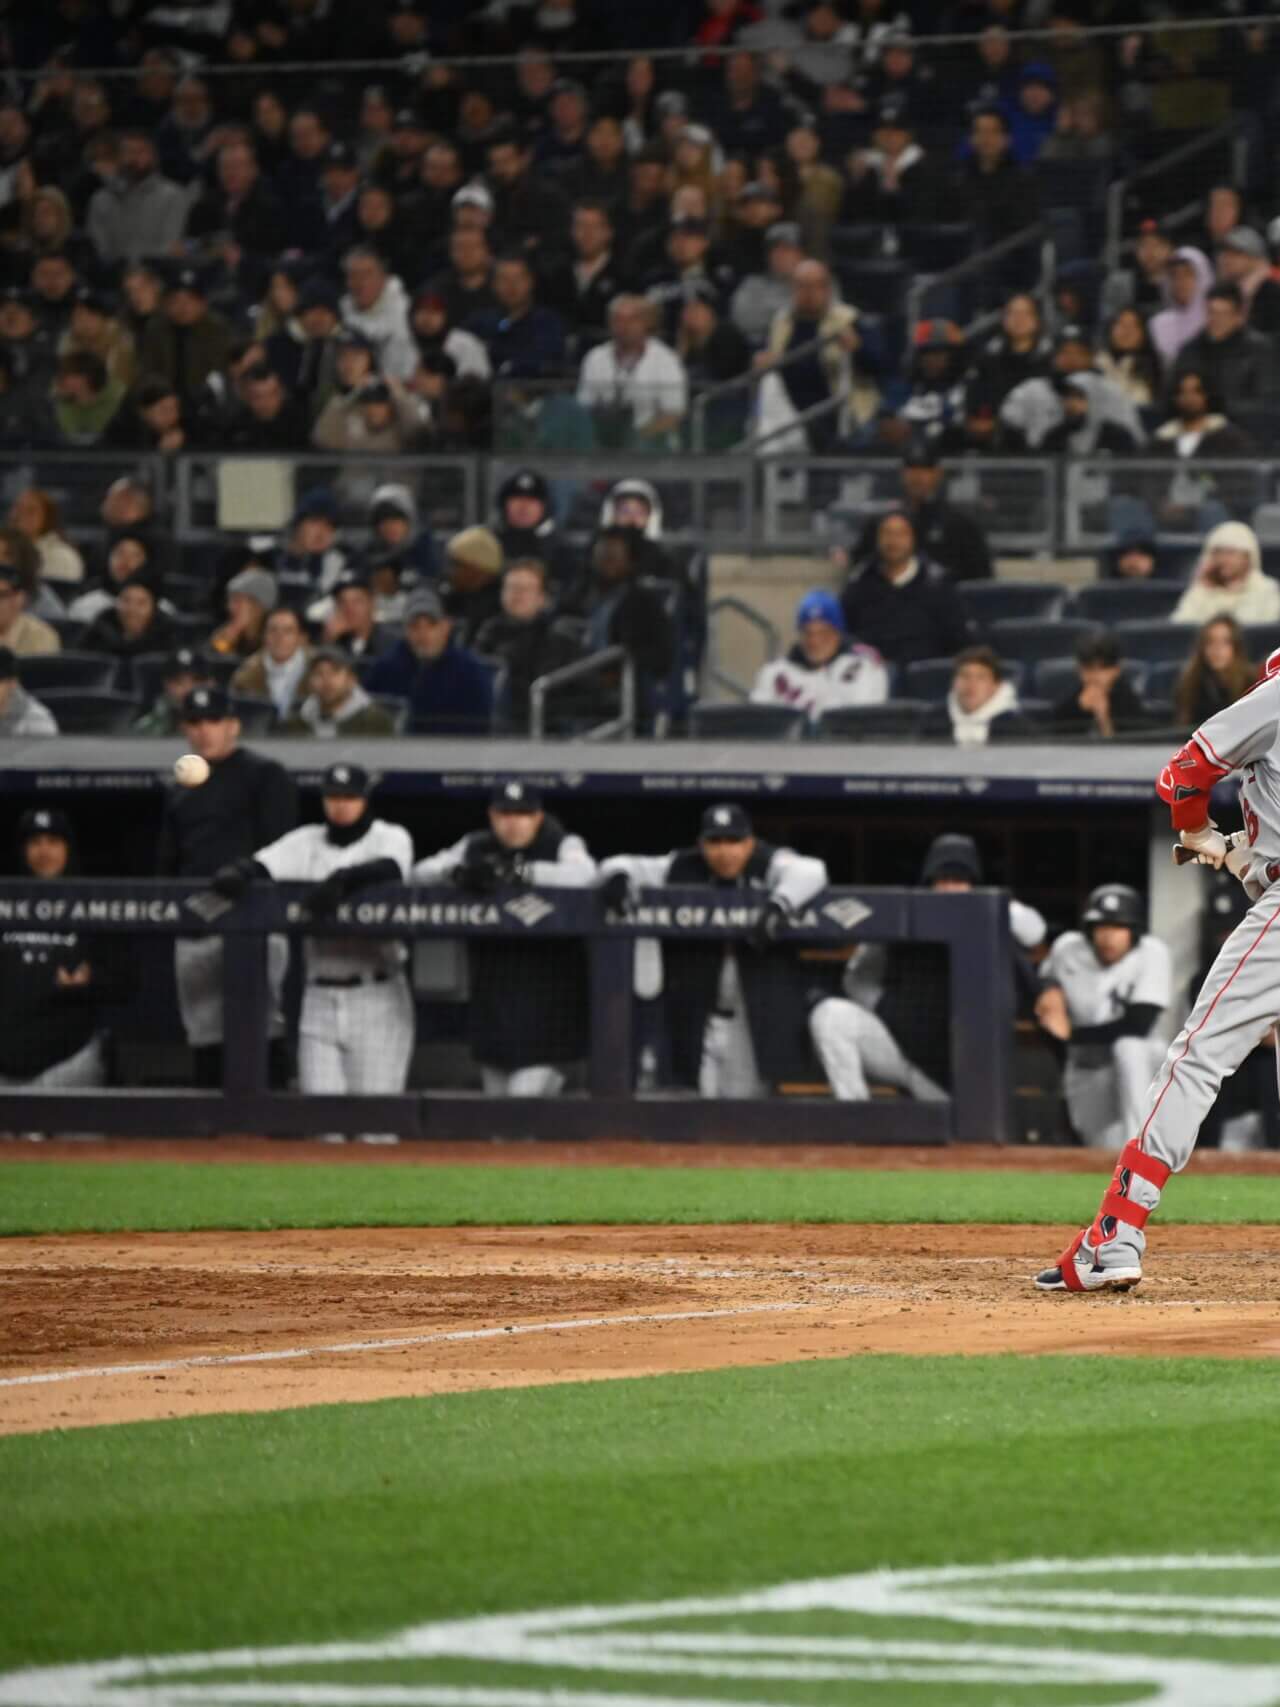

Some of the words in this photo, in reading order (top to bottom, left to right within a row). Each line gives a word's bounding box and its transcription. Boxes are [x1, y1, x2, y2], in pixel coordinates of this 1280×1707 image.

[35, 899, 67, 921] OF
[70, 900, 180, 922] AMERICA
[355, 902, 390, 924] OF
[391, 903, 500, 925] AMERICA
[675, 905, 707, 928] OF
